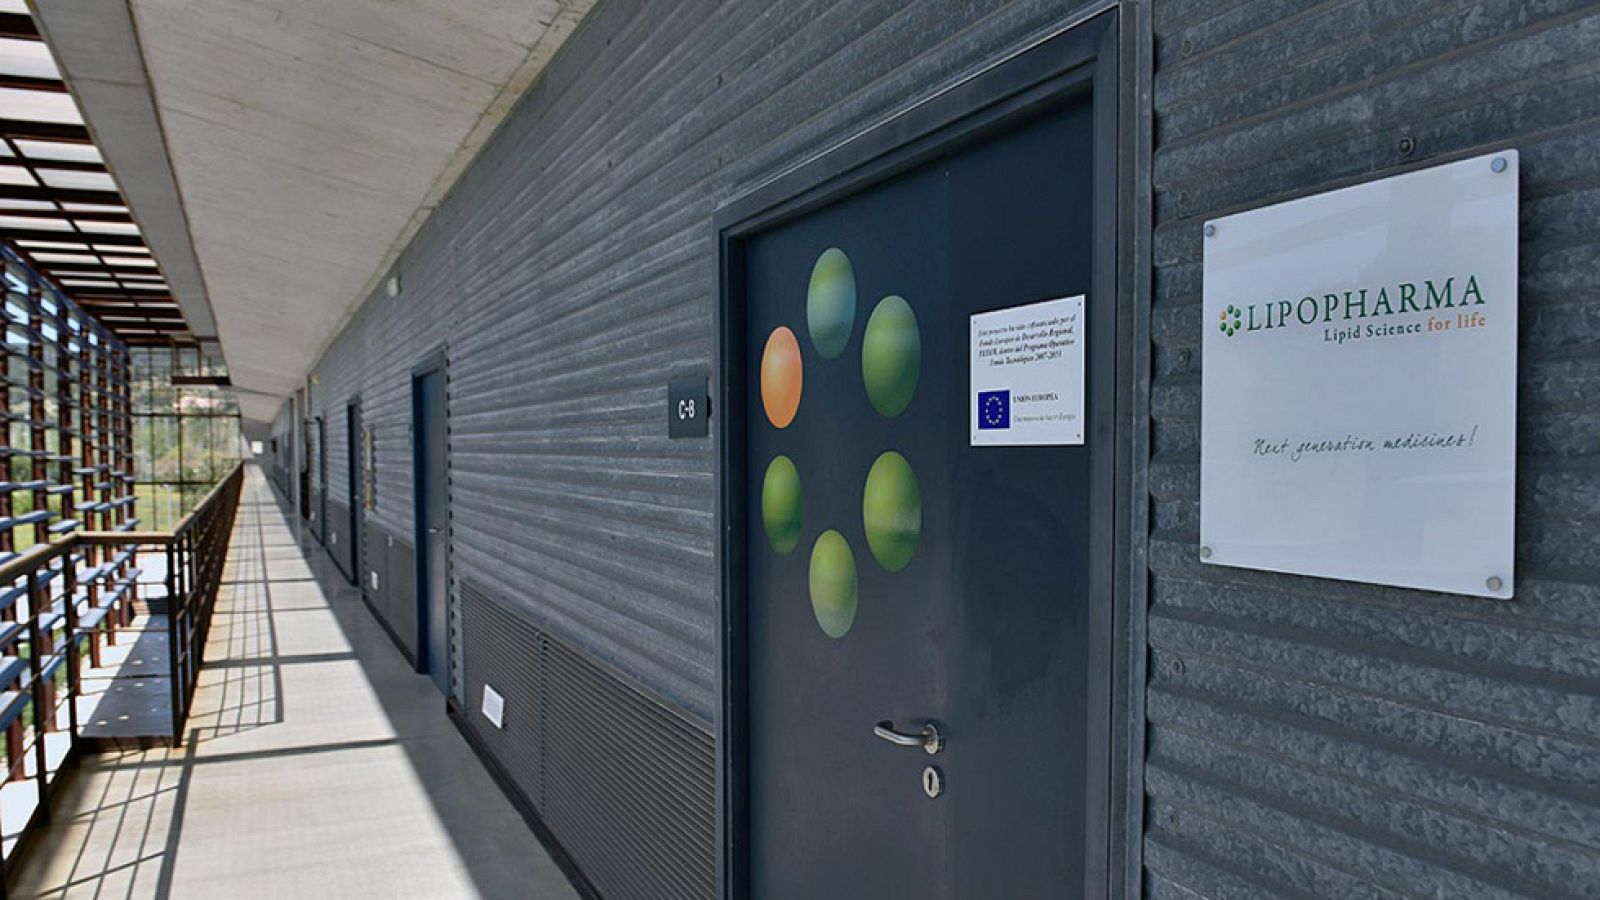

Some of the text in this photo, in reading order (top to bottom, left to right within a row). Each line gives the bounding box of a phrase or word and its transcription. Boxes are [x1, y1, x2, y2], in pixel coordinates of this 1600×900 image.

[1247, 274, 1486, 331] LIPOPHARMA
[1324, 311, 1486, 344] Lipid Science for life
[1253, 424, 1479, 463] Next generation medicines!
